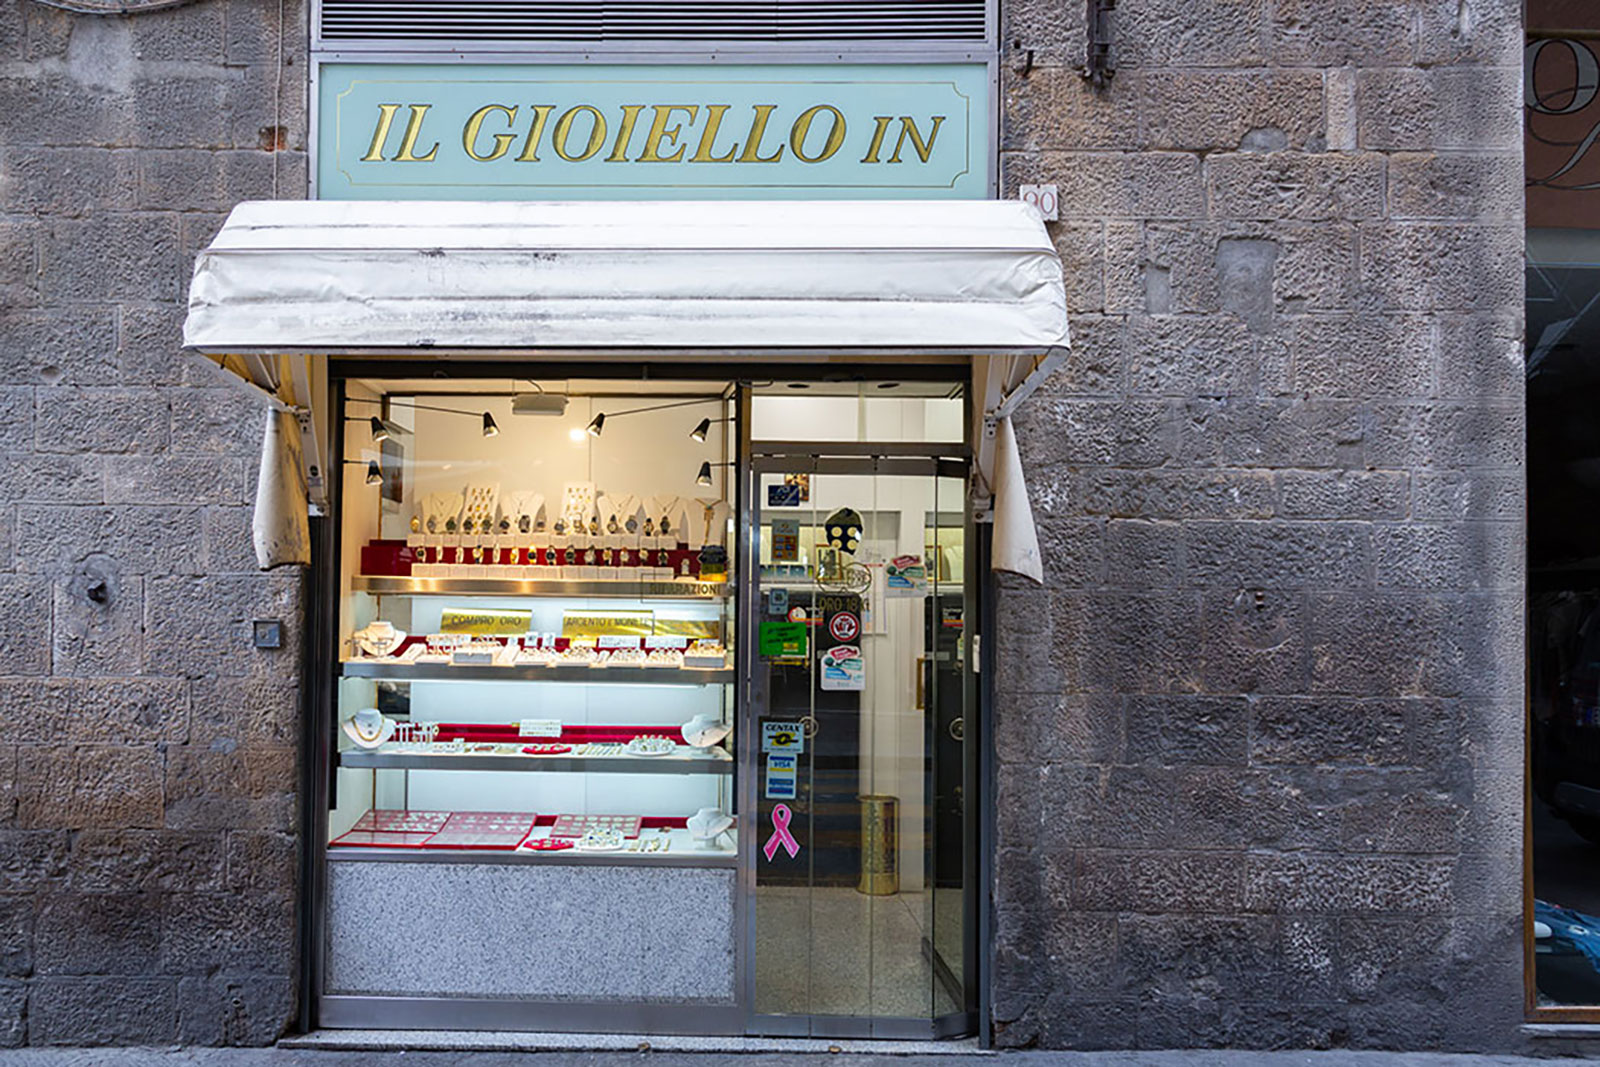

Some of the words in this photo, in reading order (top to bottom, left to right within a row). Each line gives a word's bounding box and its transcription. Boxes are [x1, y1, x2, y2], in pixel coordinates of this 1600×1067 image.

[360, 103, 440, 162] IL
[461, 103, 848, 164] GIOIELLO
[859, 116, 947, 164] IN
[818, 597, 842, 611] ORO
[451, 615, 495, 626] COMPRO
[500, 616, 521, 626] ORO
[565, 617, 606, 627] ARGENTO
[614, 617, 650, 628] MONETE
